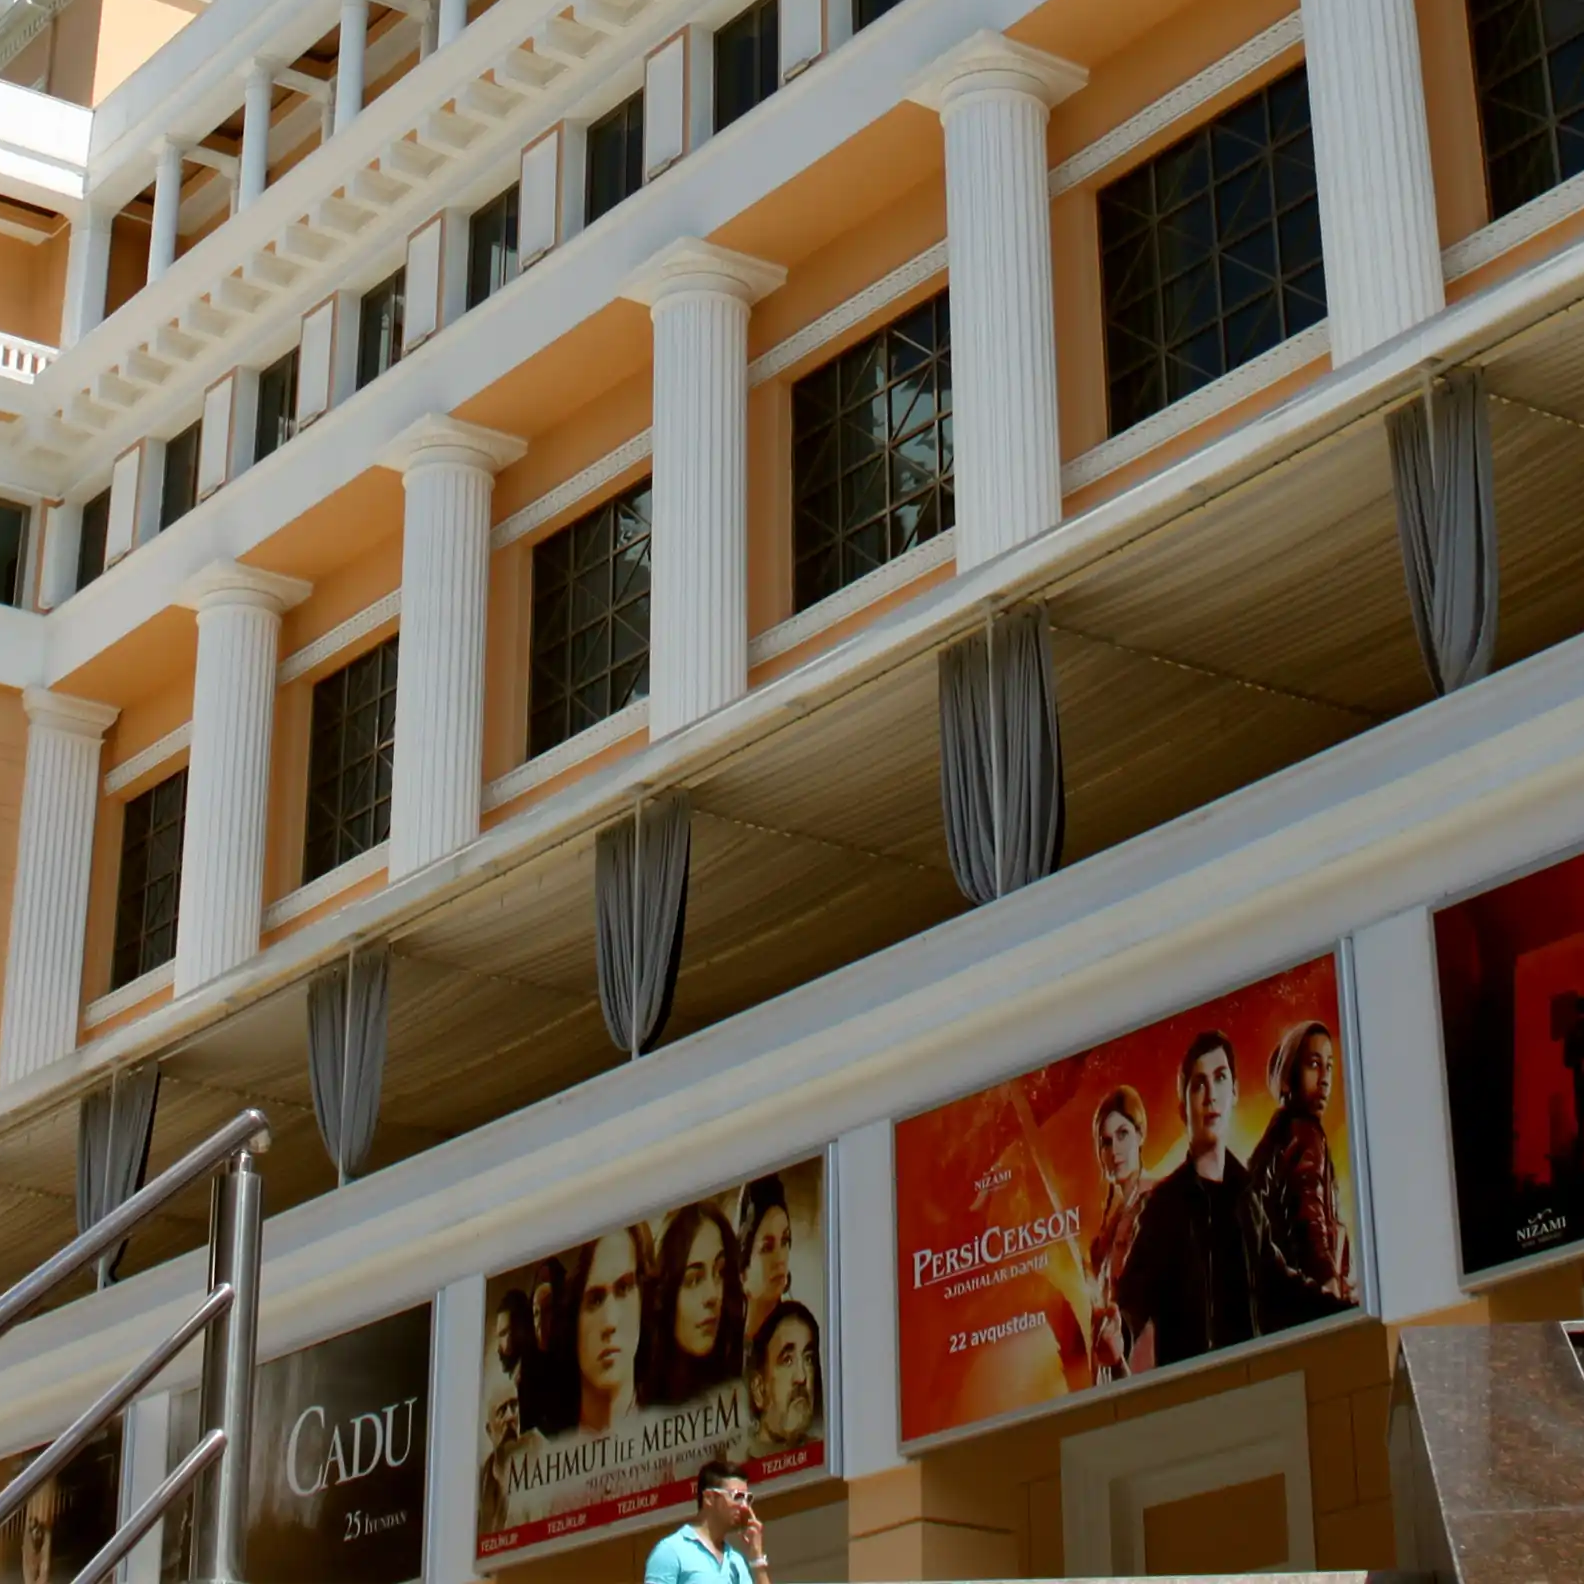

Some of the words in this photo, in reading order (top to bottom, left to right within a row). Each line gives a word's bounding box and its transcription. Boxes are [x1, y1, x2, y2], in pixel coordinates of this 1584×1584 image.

[949, 1331, 967, 1354] 22
[970, 1311, 1047, 1346] avqustdan
[286, 1397, 418, 1497] CADU
[506, 1437, 610, 1494] MAHMUT
[641, 1389, 741, 1453] MERYEM
[343, 1510, 361, 1542] 25
